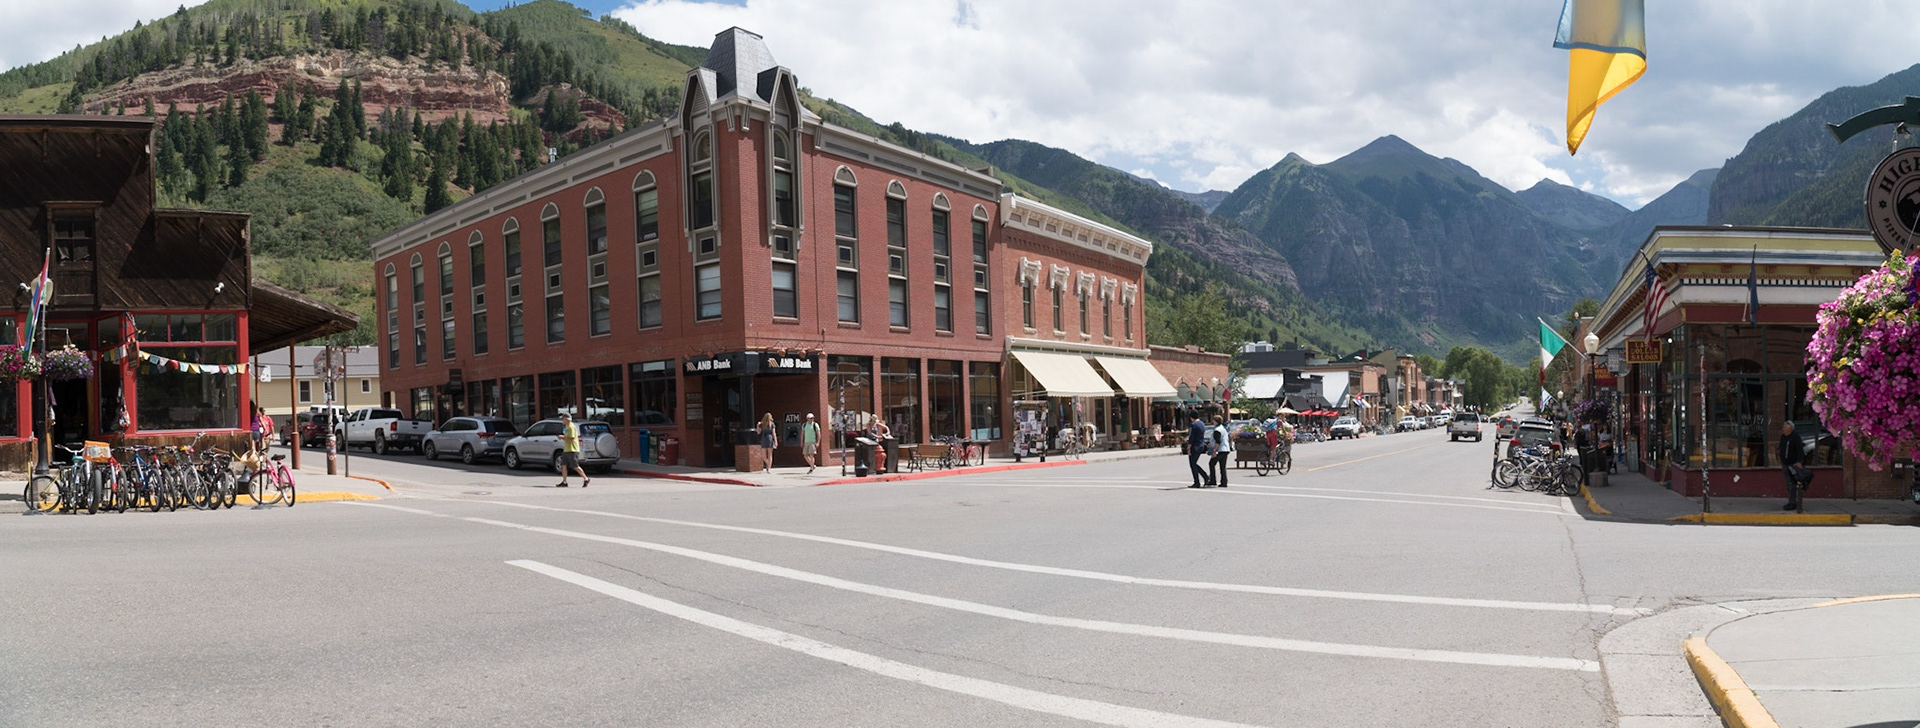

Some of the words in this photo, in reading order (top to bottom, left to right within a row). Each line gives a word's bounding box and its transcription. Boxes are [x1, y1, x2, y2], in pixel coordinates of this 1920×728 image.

[1883, 217, 1914, 251] PIZZERA
[697, 360, 711, 370] ANB
[713, 358, 731, 369] Bank
[779, 357, 794, 368] ANB
[795, 358, 812, 368] Bank
[785, 414, 800, 422] ATM
